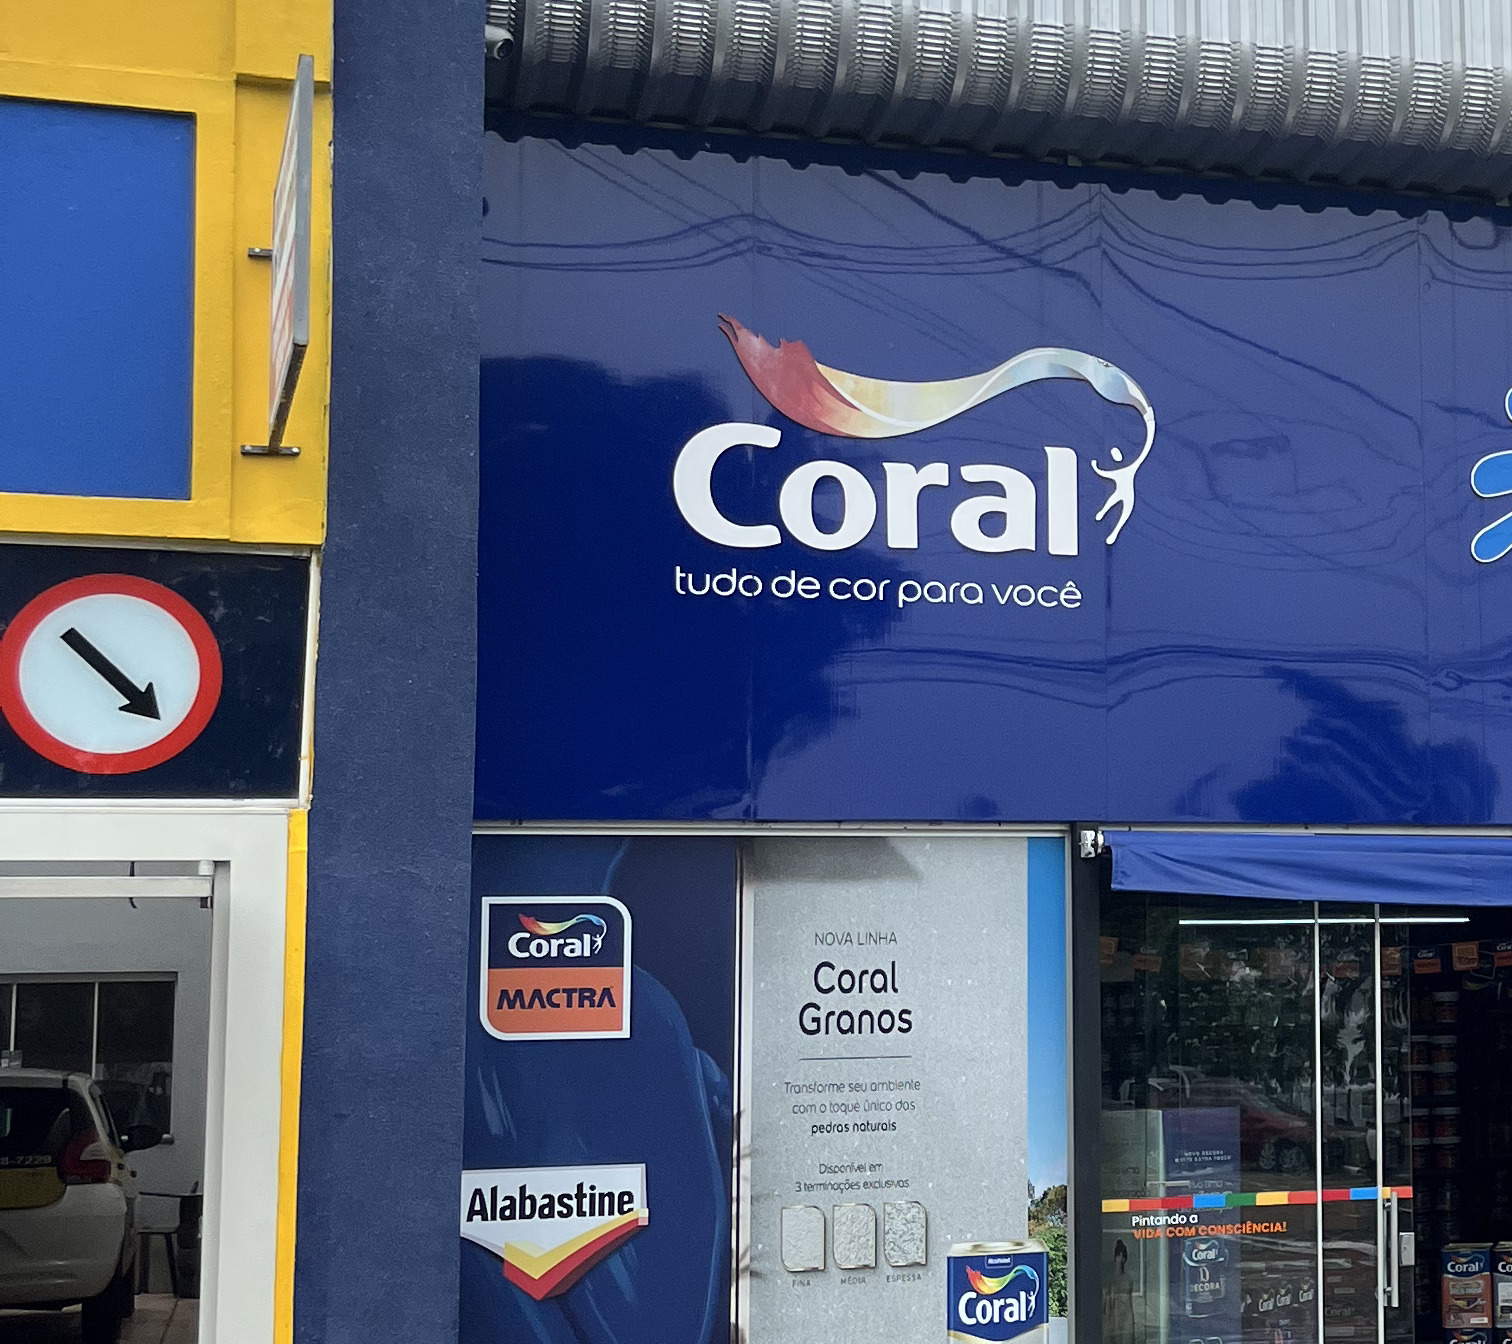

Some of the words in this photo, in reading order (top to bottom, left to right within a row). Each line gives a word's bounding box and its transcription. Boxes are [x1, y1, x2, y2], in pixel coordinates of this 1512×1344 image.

[673, 422, 1079, 556] Coral
[674, 565, 763, 597] tudo
[771, 569, 821, 600] de
[828, 574, 890, 601] cor
[897, 577, 984, 608] para
[990, 580, 1083, 608] você
[508, 932, 592, 958] Coral
[814, 931, 853, 947] NOVA
[857, 931, 898, 946] LINHA
[813, 960, 899, 994] Coral
[497, 987, 617, 1010] MACTRA
[799, 1002, 913, 1036] Granos
[784, 1081, 846, 1095] Transforme
[848, 1082, 868, 1093] seu
[870, 1078, 921, 1092] ambiente
[792, 1103, 817, 1115] com
[819, 1103, 827, 1114] o
[829, 1100, 861, 1116] toque
[863, 1099, 892, 1112] único
[895, 1098, 916, 1111] das
[811, 1121, 850, 1136] pedras
[852, 1118, 897, 1133] naturais
[819, 1162, 867, 1175] Disponível
[869, 1163, 884, 1173] em
[795, 1181, 802, 1192] 3
[863, 1178, 910, 1190] exclusivas
[466, 1181, 635, 1223] Alabastine
[1131, 1213, 1187, 1227] Pintando
[1189, 1214, 1199, 1224] a
[1132, 1228, 1164, 1239] VIDA
[1165, 1226, 1195, 1238] COM
[1197, 1220, 1288, 1236] CONSCIÊNCIA!
[1192, 1248, 1216, 1261] Coral
[1447, 1261, 1480, 1273] Coral
[792, 1279, 811, 1288] FINA
[840, 1275, 867, 1285] MÉDIA
[886, 1272, 922, 1283] ESPESSA
[958, 1290, 1027, 1325] Coral
